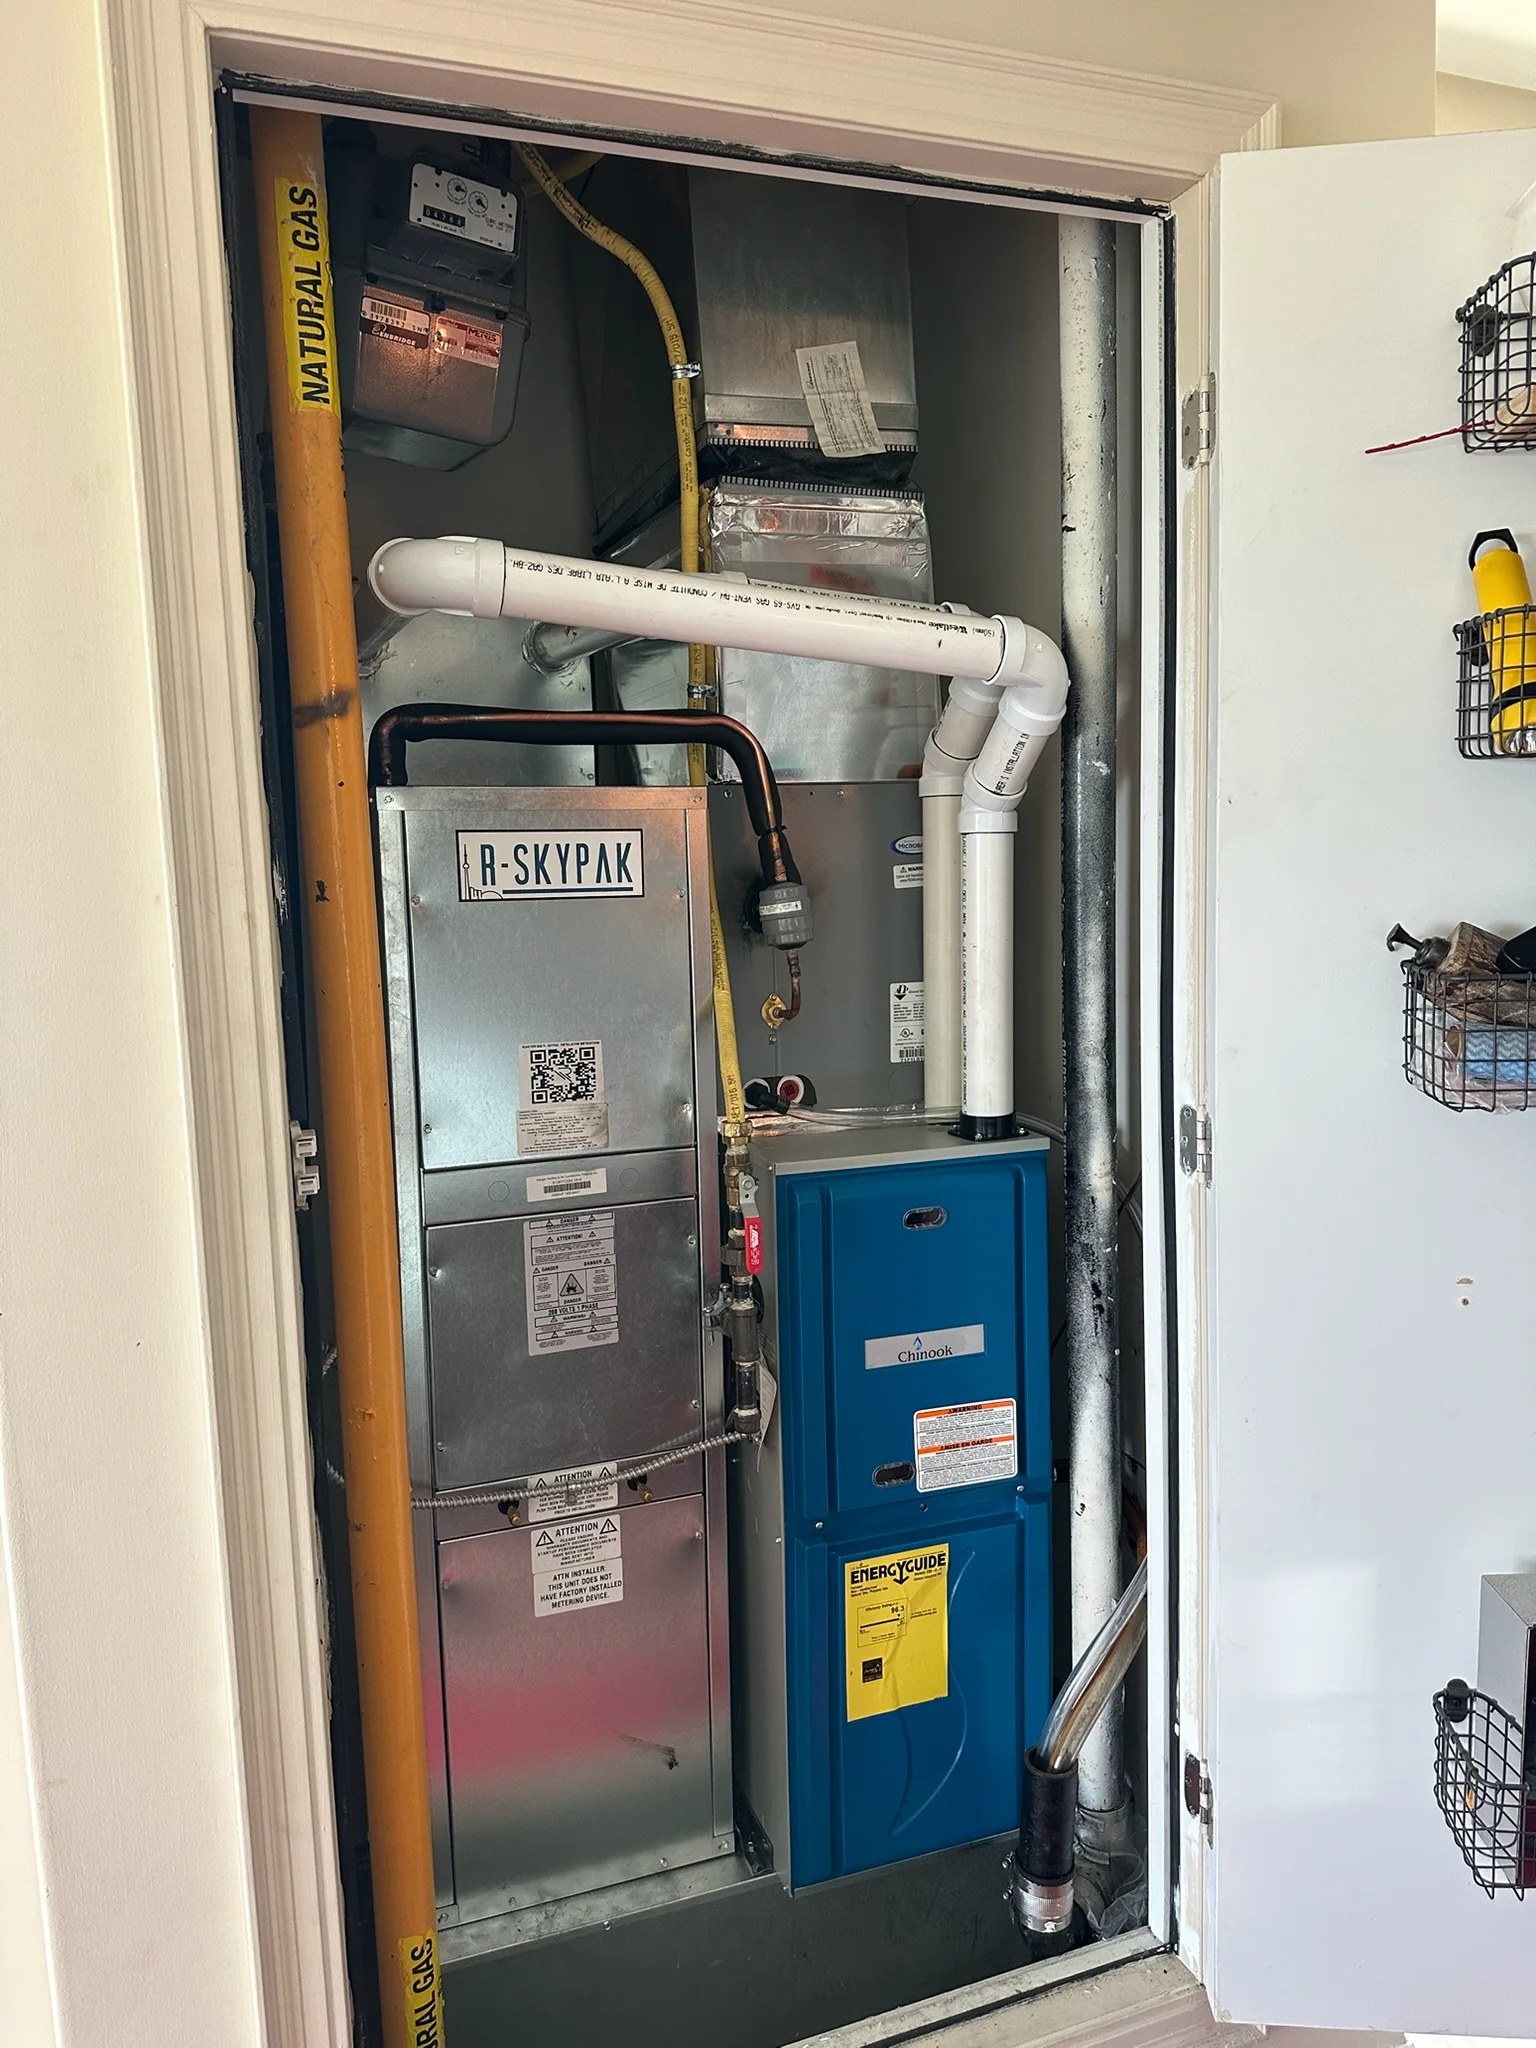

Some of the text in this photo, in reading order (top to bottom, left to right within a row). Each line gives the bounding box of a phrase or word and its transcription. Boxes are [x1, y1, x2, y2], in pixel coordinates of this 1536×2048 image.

[288, 186, 330, 404] NATURAL GAS
[370, 313, 405, 328] 3978393
[380, 331, 417, 346] ENBRIDGE
[595, 572, 621, 584] L'AIR
[927, 621, 968, 634] Westlake
[1003, 741, 1027, 775] INSTALLATION
[480, 843, 633, 886] R-SKYPAK
[898, 1345, 953, 1363] Chinook
[953, 1404, 983, 1413] WARNING
[972, 1438, 993, 1446] GARDE
[554, 1470, 593, 1483] ATTENTION
[556, 1522, 599, 1537] ATTENTION
[538, 1538, 617, 1557] STARTUP PERFORMANCE DOCUMENTS
[546, 1542, 571, 1550] WARRANTY
[572, 1537, 598, 1545] DOCUMENTS
[577, 1545, 602, 1553] COMPLETED
[851, 1552, 946, 1585] ENERGYGUIDE
[548, 1573, 612, 1591] THIS UNIT DOES NOT
[553, 1573, 570, 1581] ATTN
[540, 1580, 622, 1602] HAVE FACTORY INSTALLED
[552, 1592, 610, 1609] METERING DEVICE.
[410, 1938, 434, 1994] GAS
